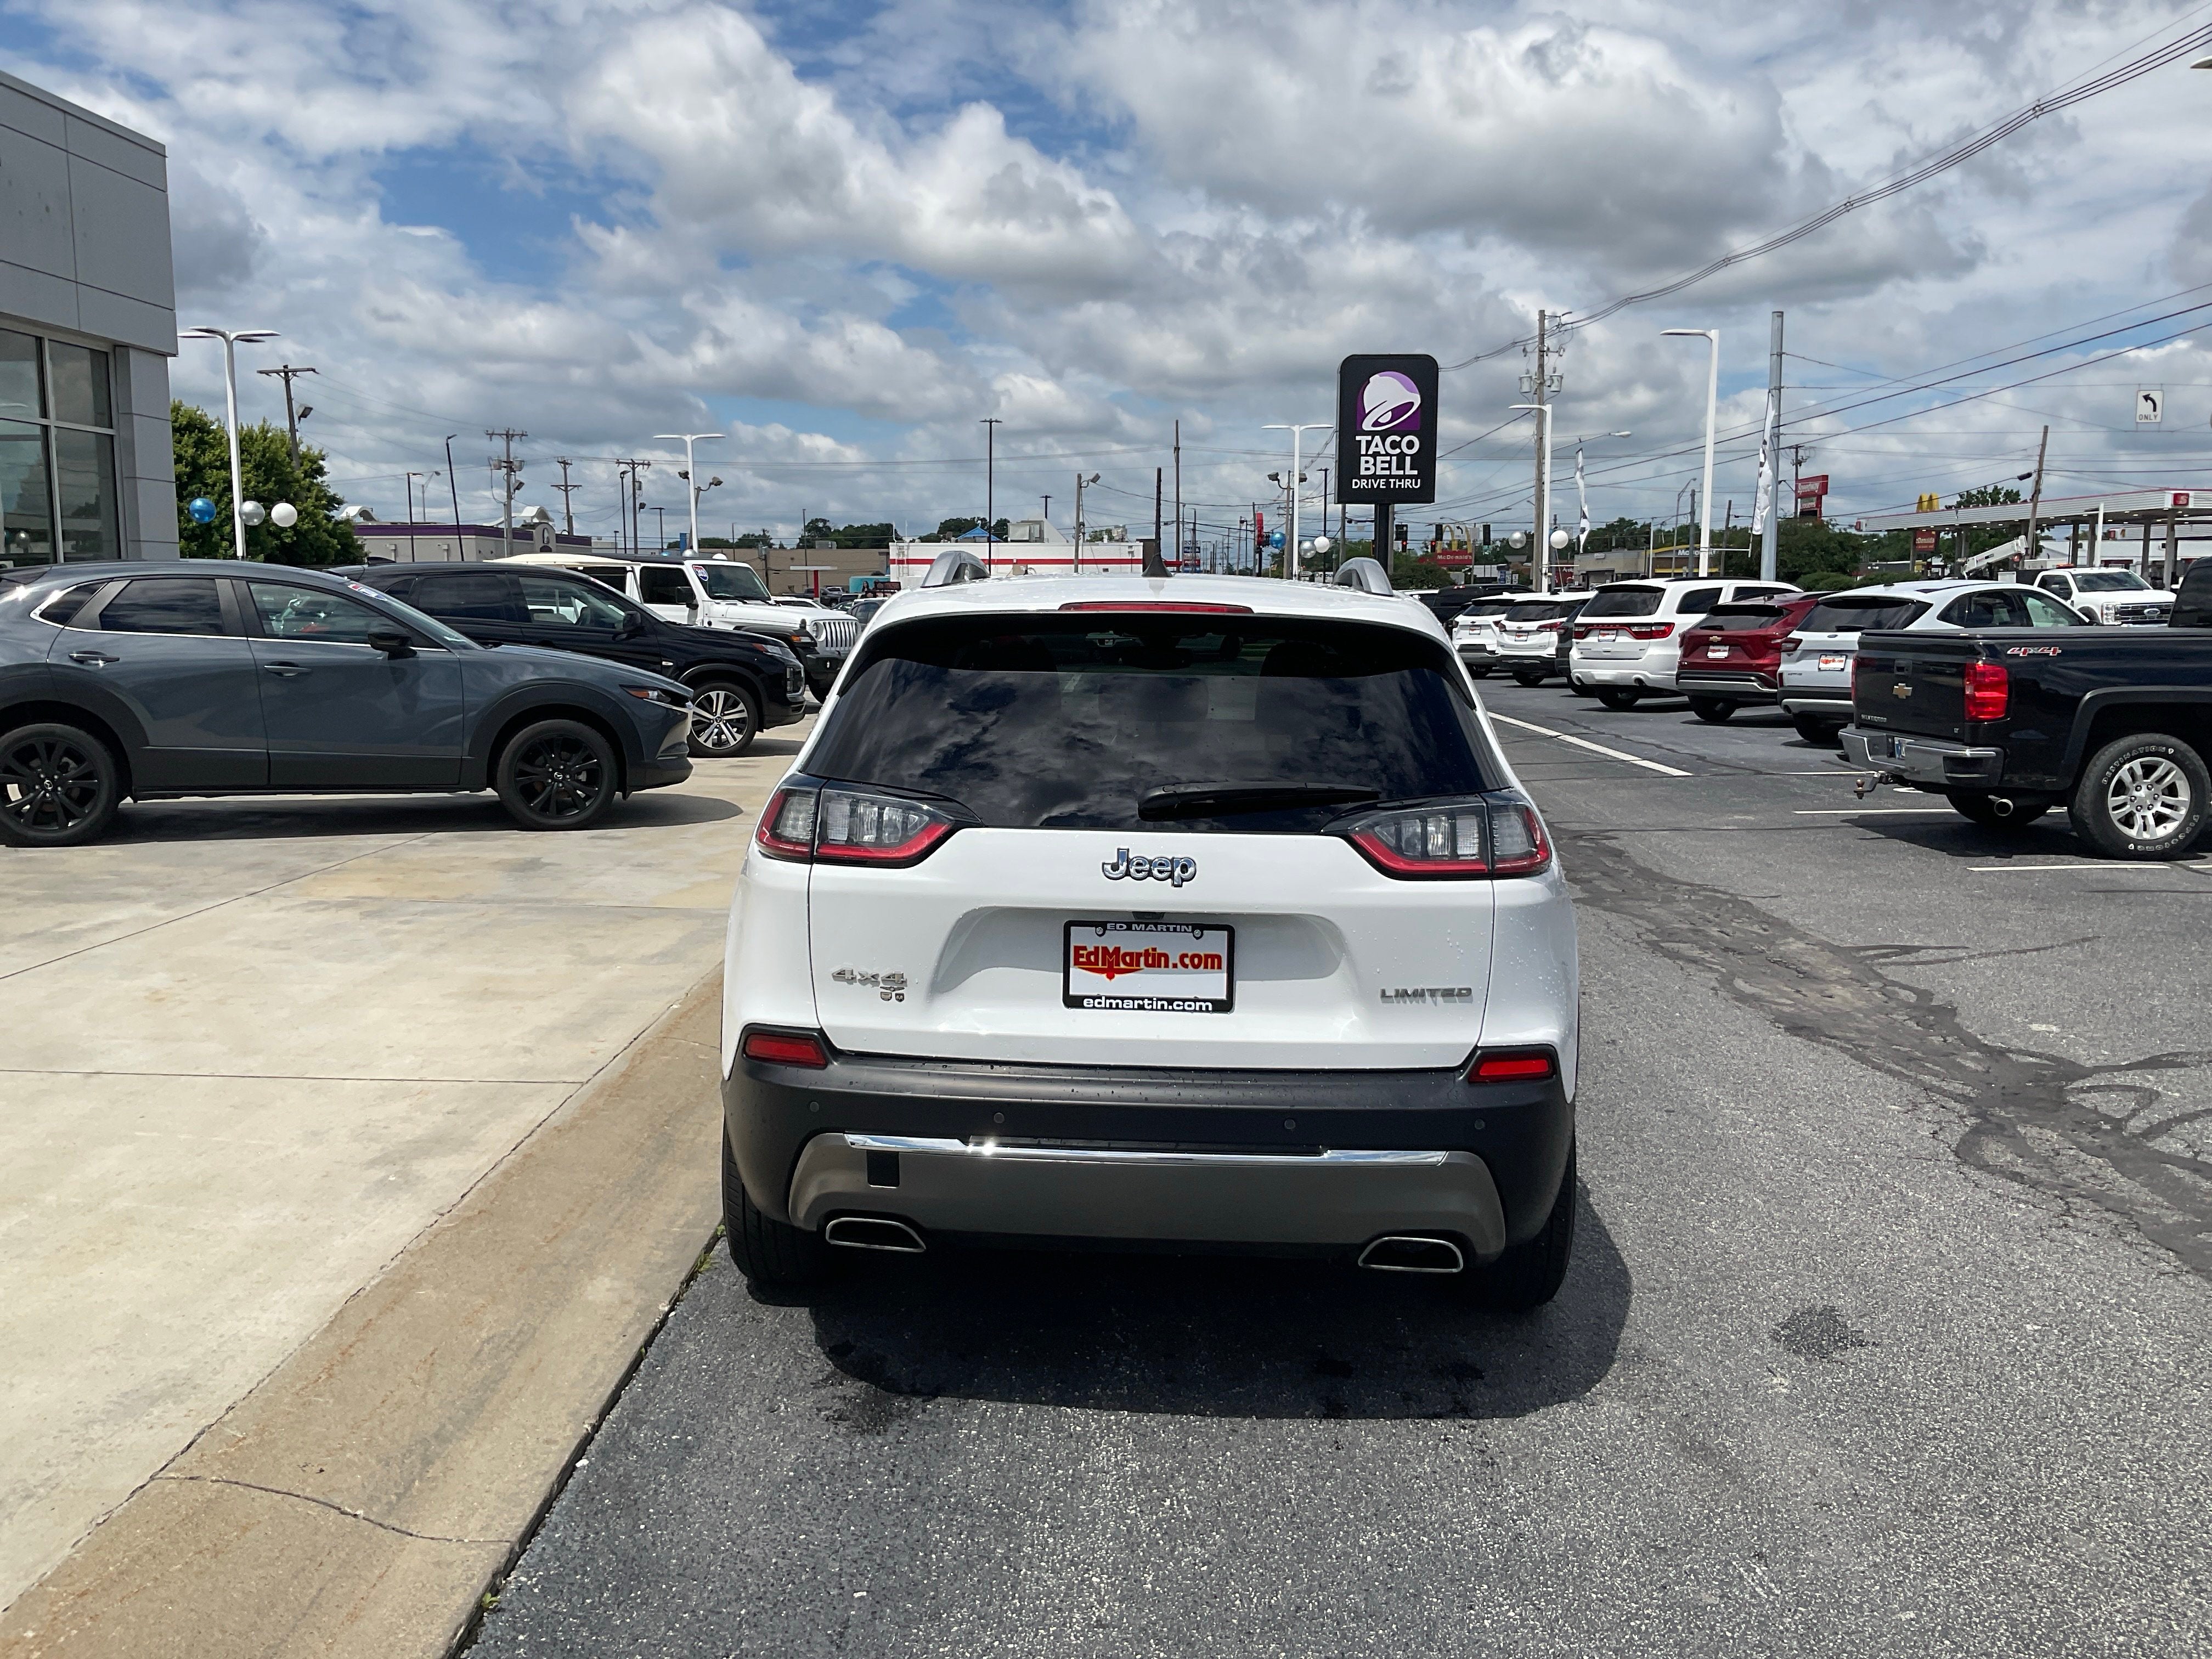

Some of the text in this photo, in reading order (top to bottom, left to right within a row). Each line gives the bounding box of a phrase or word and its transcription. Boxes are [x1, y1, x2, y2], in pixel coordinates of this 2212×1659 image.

[1355, 435, 1420, 455] TACO
[1360, 456, 1418, 475] BELL
[1352, 479, 1421, 489] DRIVE THRU
[2102, 745, 2166, 785] DESTINATION
[1102, 848, 1197, 888] Jeep
[1132, 924, 1192, 932] MARTIN
[1073, 945, 1222, 970] EdMartin.com
[831, 967, 908, 986] 4x4
[1380, 988, 1472, 998] LIMITED
[1083, 996, 1213, 1011] edmartin.com
